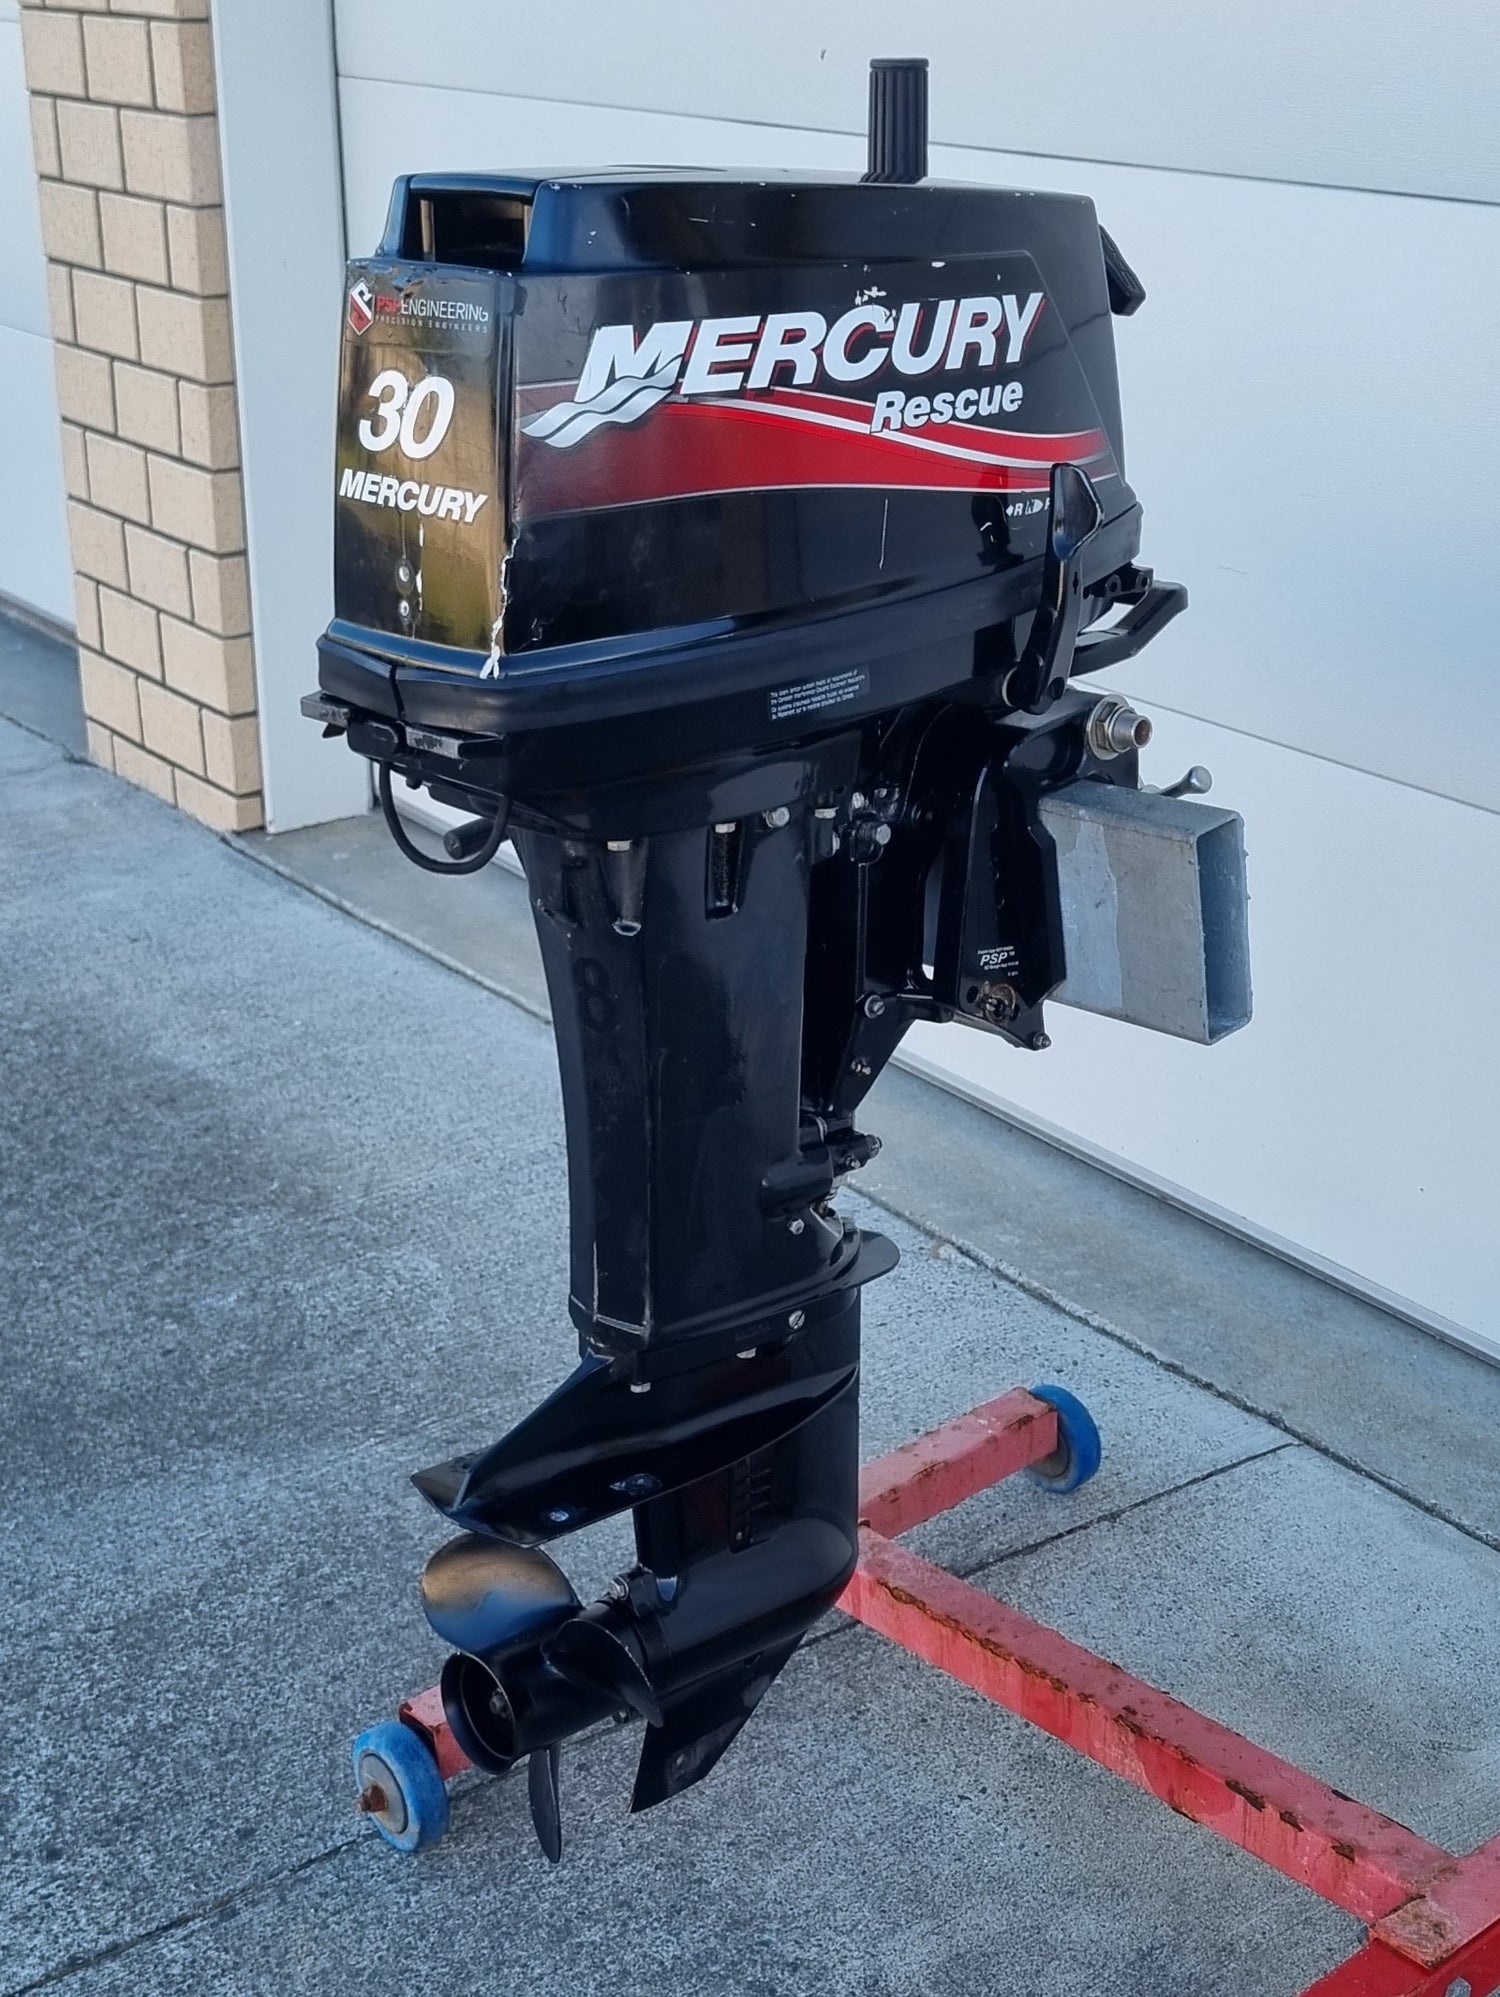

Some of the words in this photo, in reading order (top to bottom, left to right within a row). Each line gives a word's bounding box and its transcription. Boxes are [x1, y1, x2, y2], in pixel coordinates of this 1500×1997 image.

[376, 315, 423, 327] PRECISION
[428, 321, 488, 333] ENGINEERS
[574, 292, 1044, 403] MERCURY
[359, 369, 455, 460] 30
[870, 381, 1024, 434] Rescue
[339, 469, 488, 524] MERCURY
[980, 952, 1008, 966] PSP
